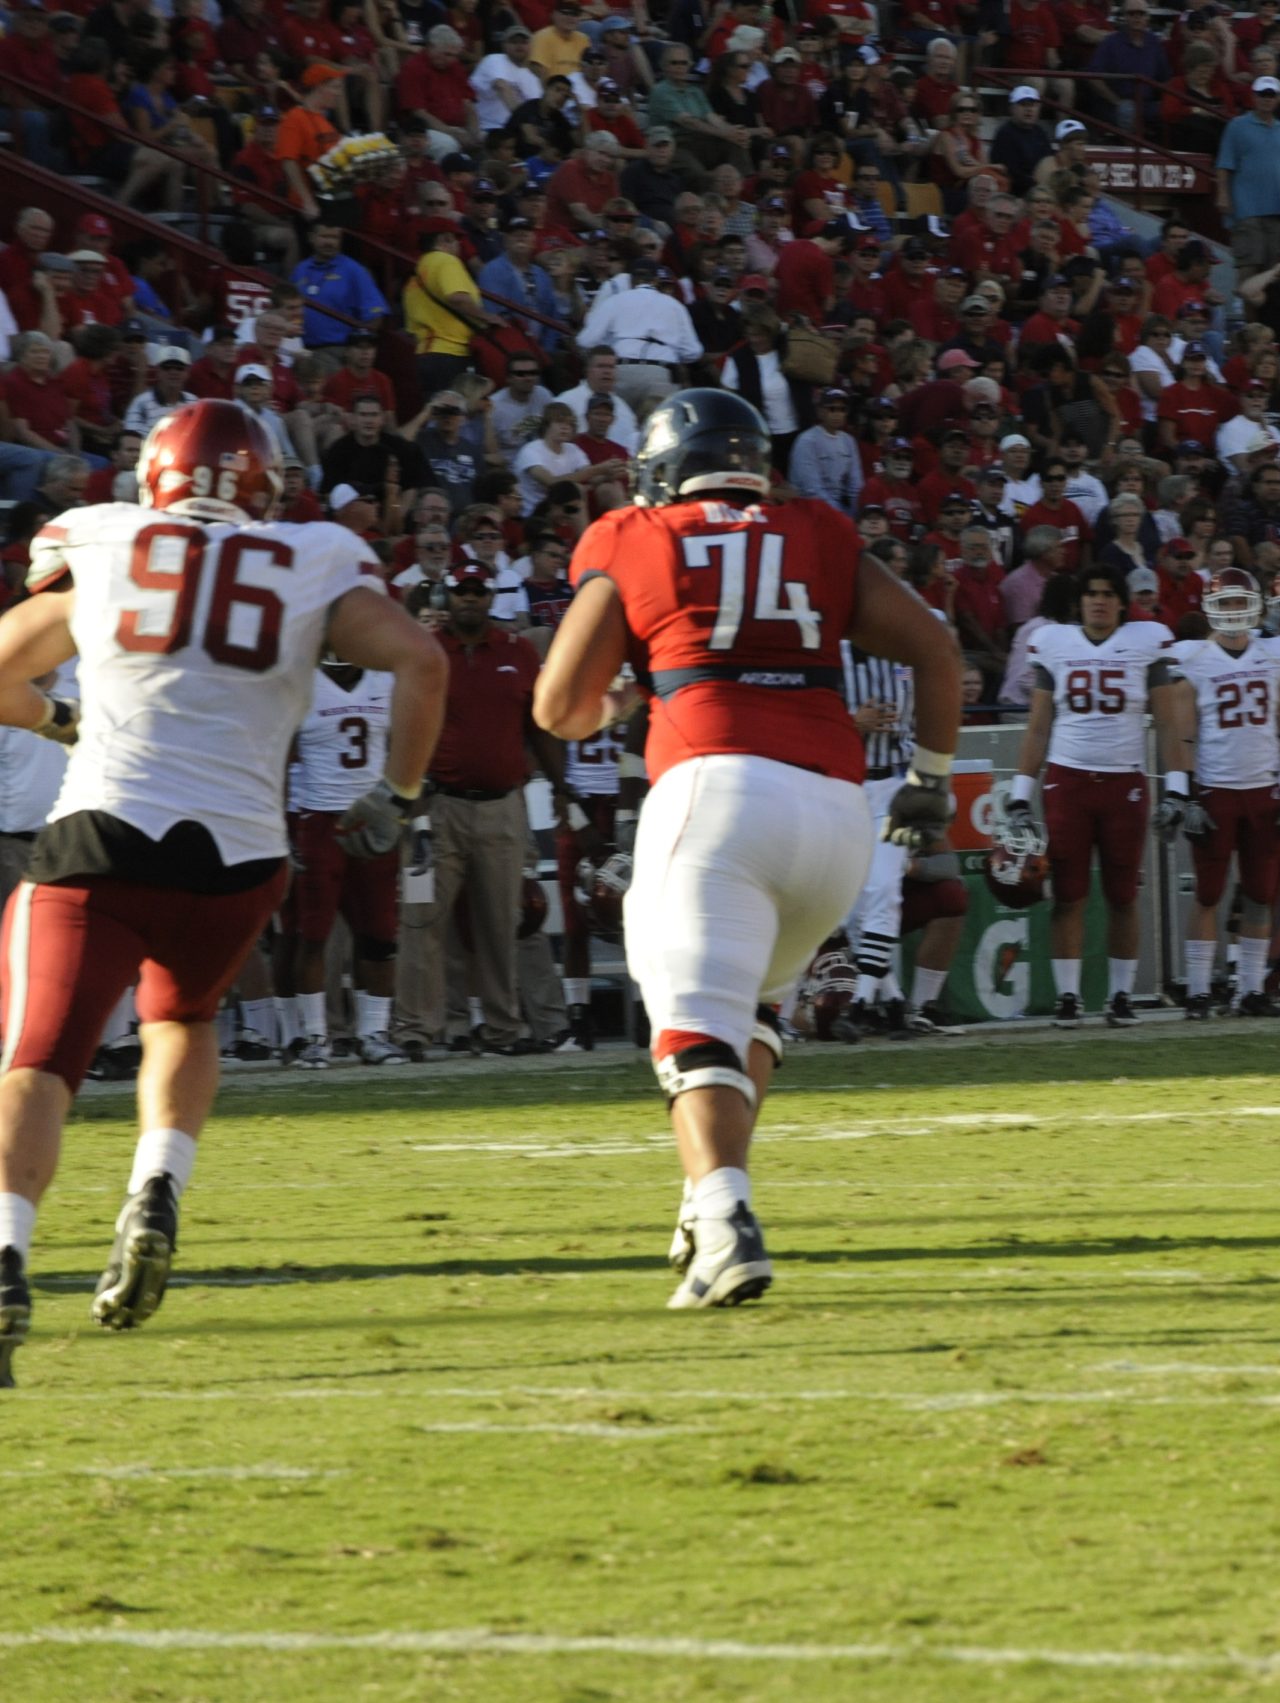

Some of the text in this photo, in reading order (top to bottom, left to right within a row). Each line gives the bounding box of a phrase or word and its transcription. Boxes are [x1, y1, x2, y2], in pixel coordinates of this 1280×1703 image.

[1110, 163, 1163, 187] SECION
[190, 466, 239, 501] 96
[114, 524, 294, 674] 96
[681, 530, 822, 650] 74
[1066, 669, 1126, 715] 85
[1216, 680, 1268, 729] 23
[339, 716, 368, 770] 3
[973, 916, 1032, 1019] G
